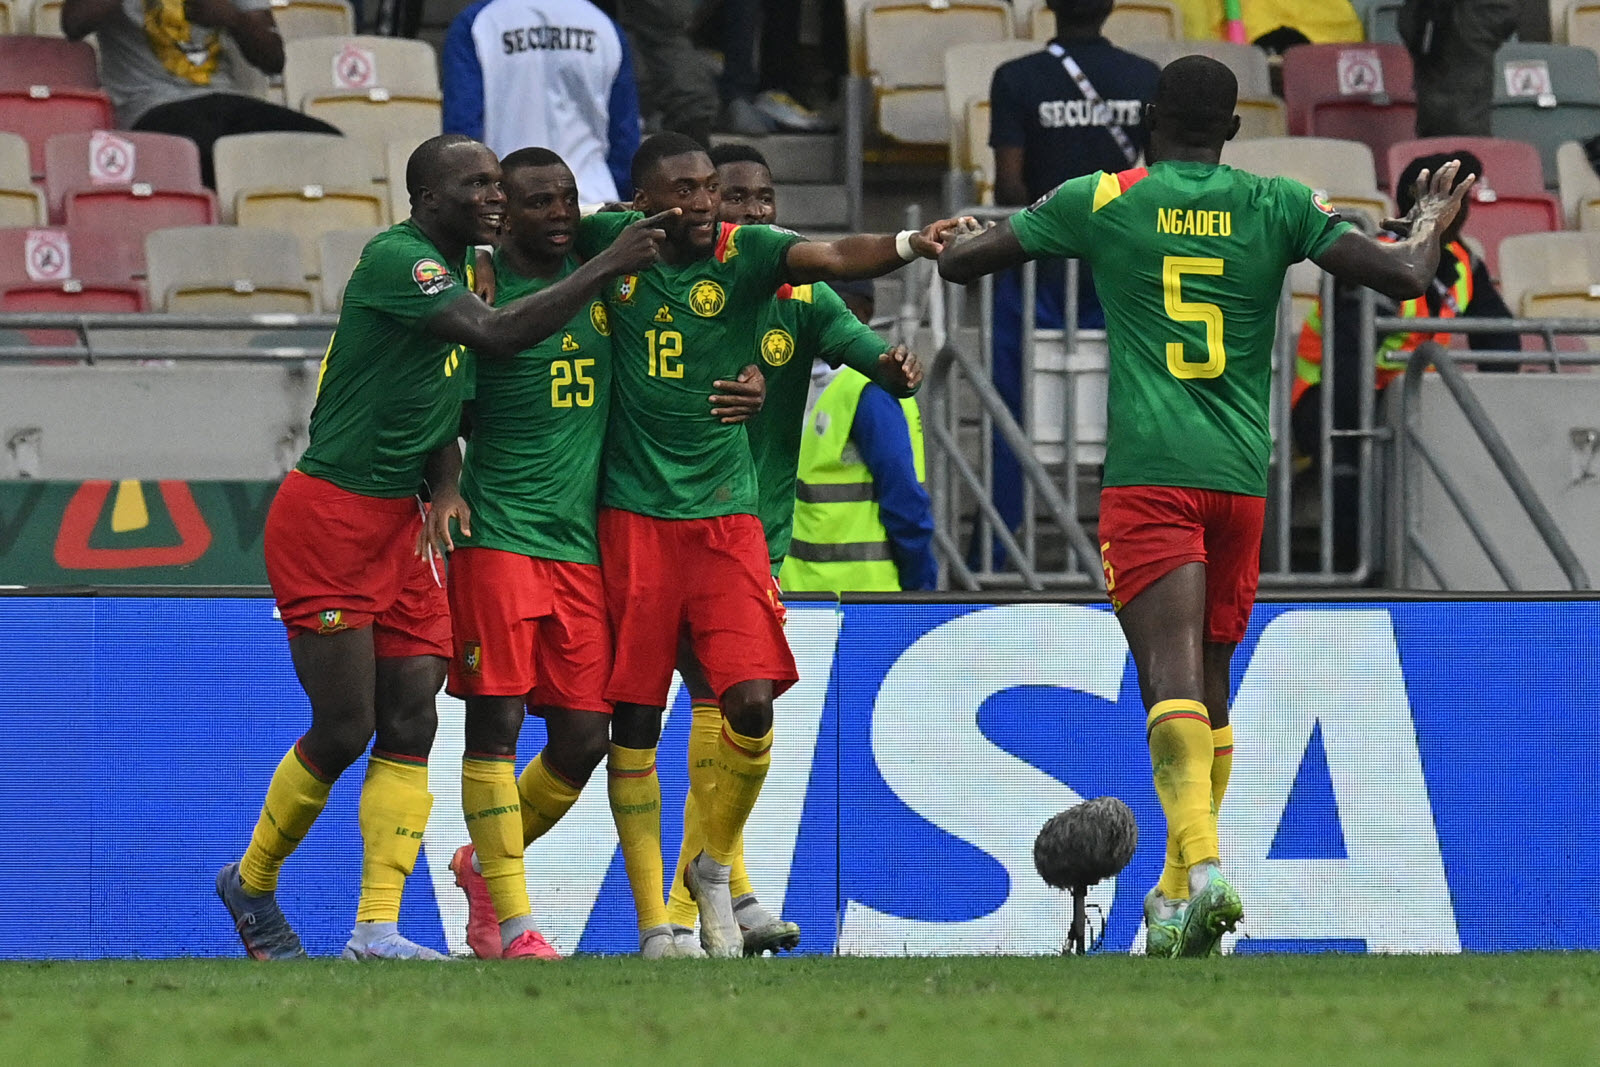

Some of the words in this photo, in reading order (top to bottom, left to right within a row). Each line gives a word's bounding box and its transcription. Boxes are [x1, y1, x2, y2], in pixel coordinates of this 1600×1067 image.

[502, 26, 597, 55] SECURITE
[1156, 207, 1232, 237] NGADEU
[1162, 255, 1227, 380] 5
[644, 328, 685, 379] 12
[550, 357, 596, 408] 25
